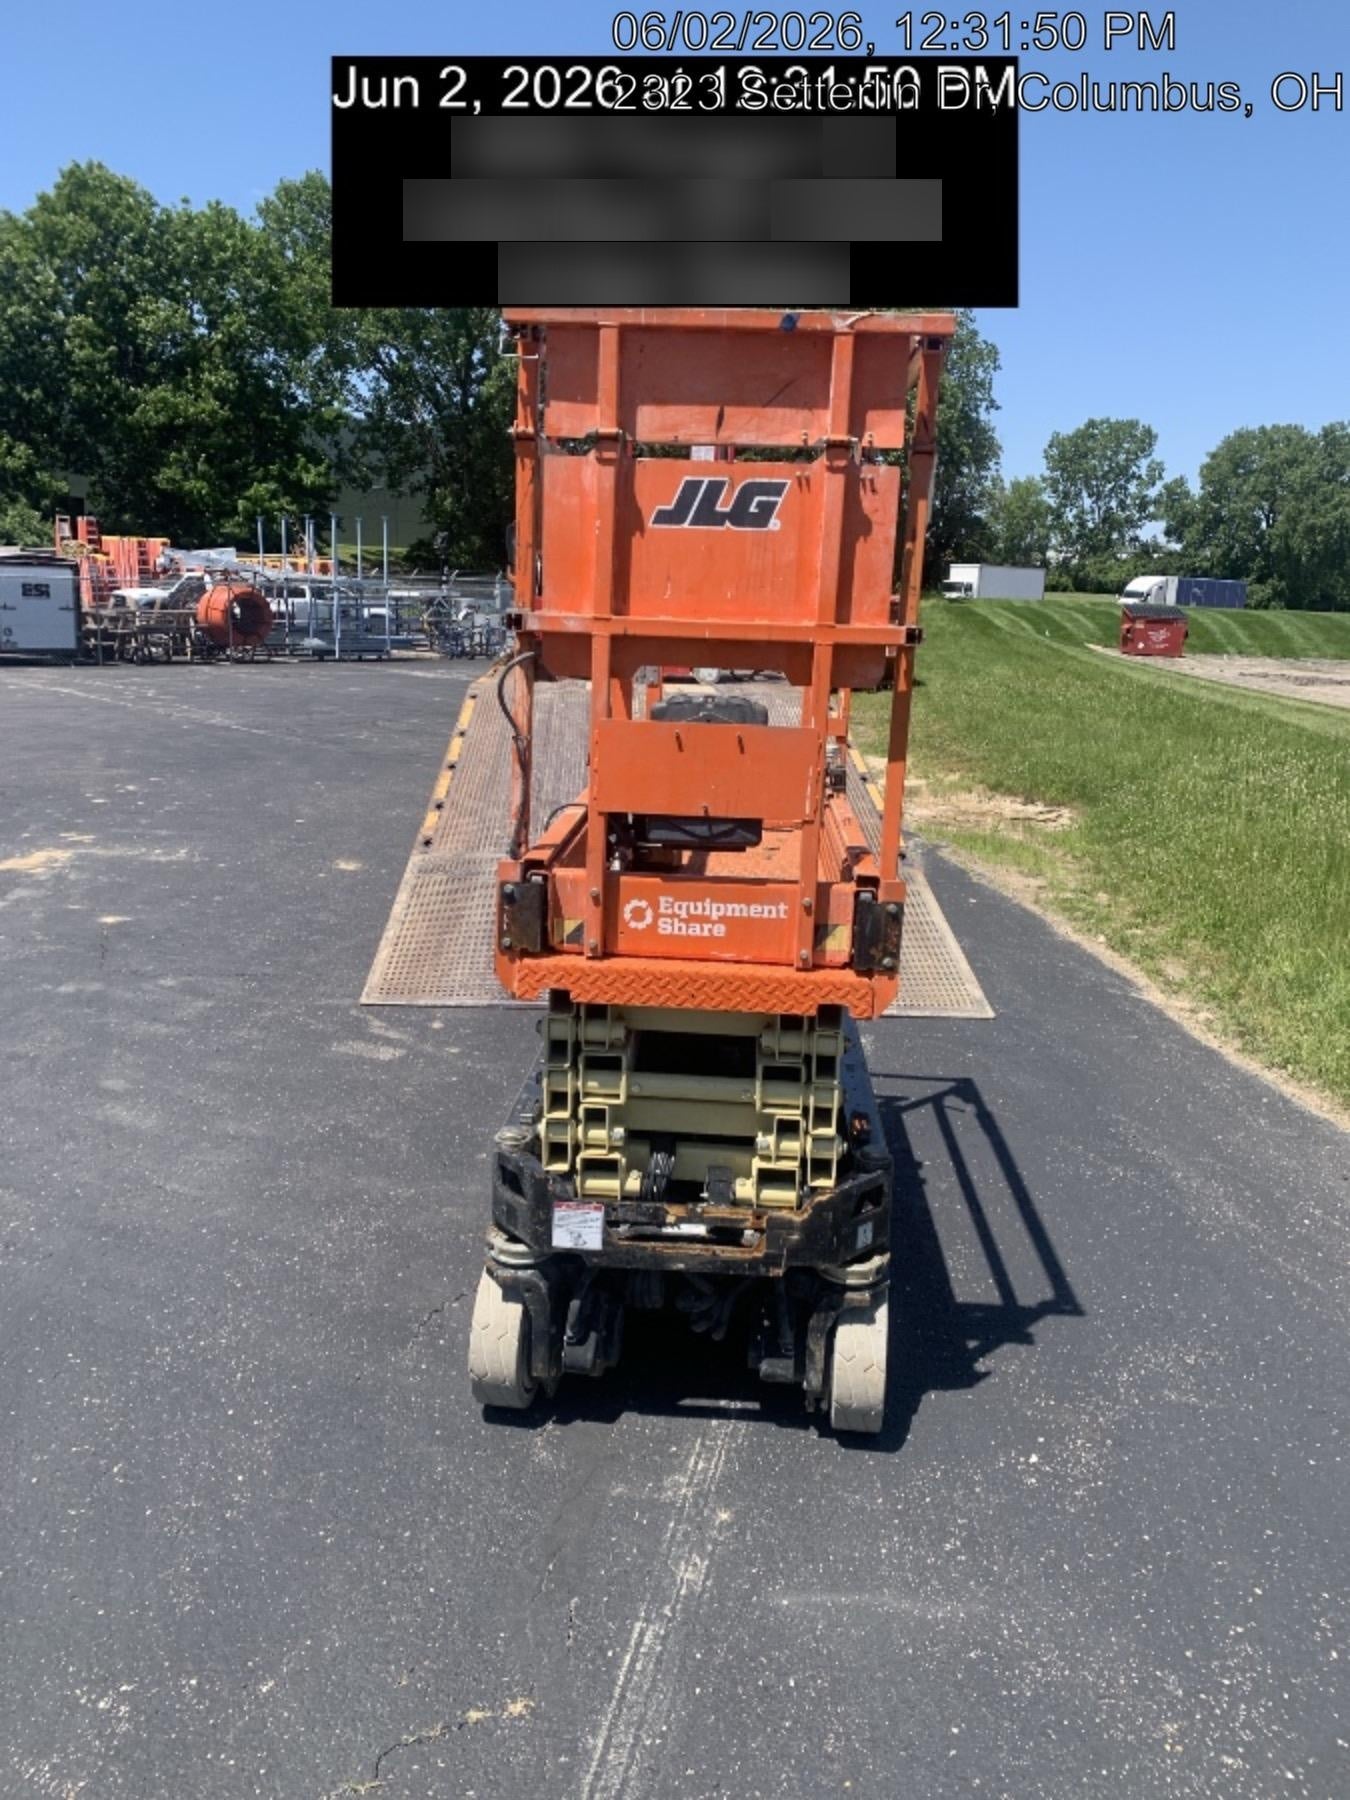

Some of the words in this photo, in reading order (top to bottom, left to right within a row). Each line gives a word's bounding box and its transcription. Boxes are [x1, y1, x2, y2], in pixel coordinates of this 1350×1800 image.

[649, 476, 791, 531] JLG
[658, 895, 788, 920] Equipment
[657, 917, 726, 937] Share
